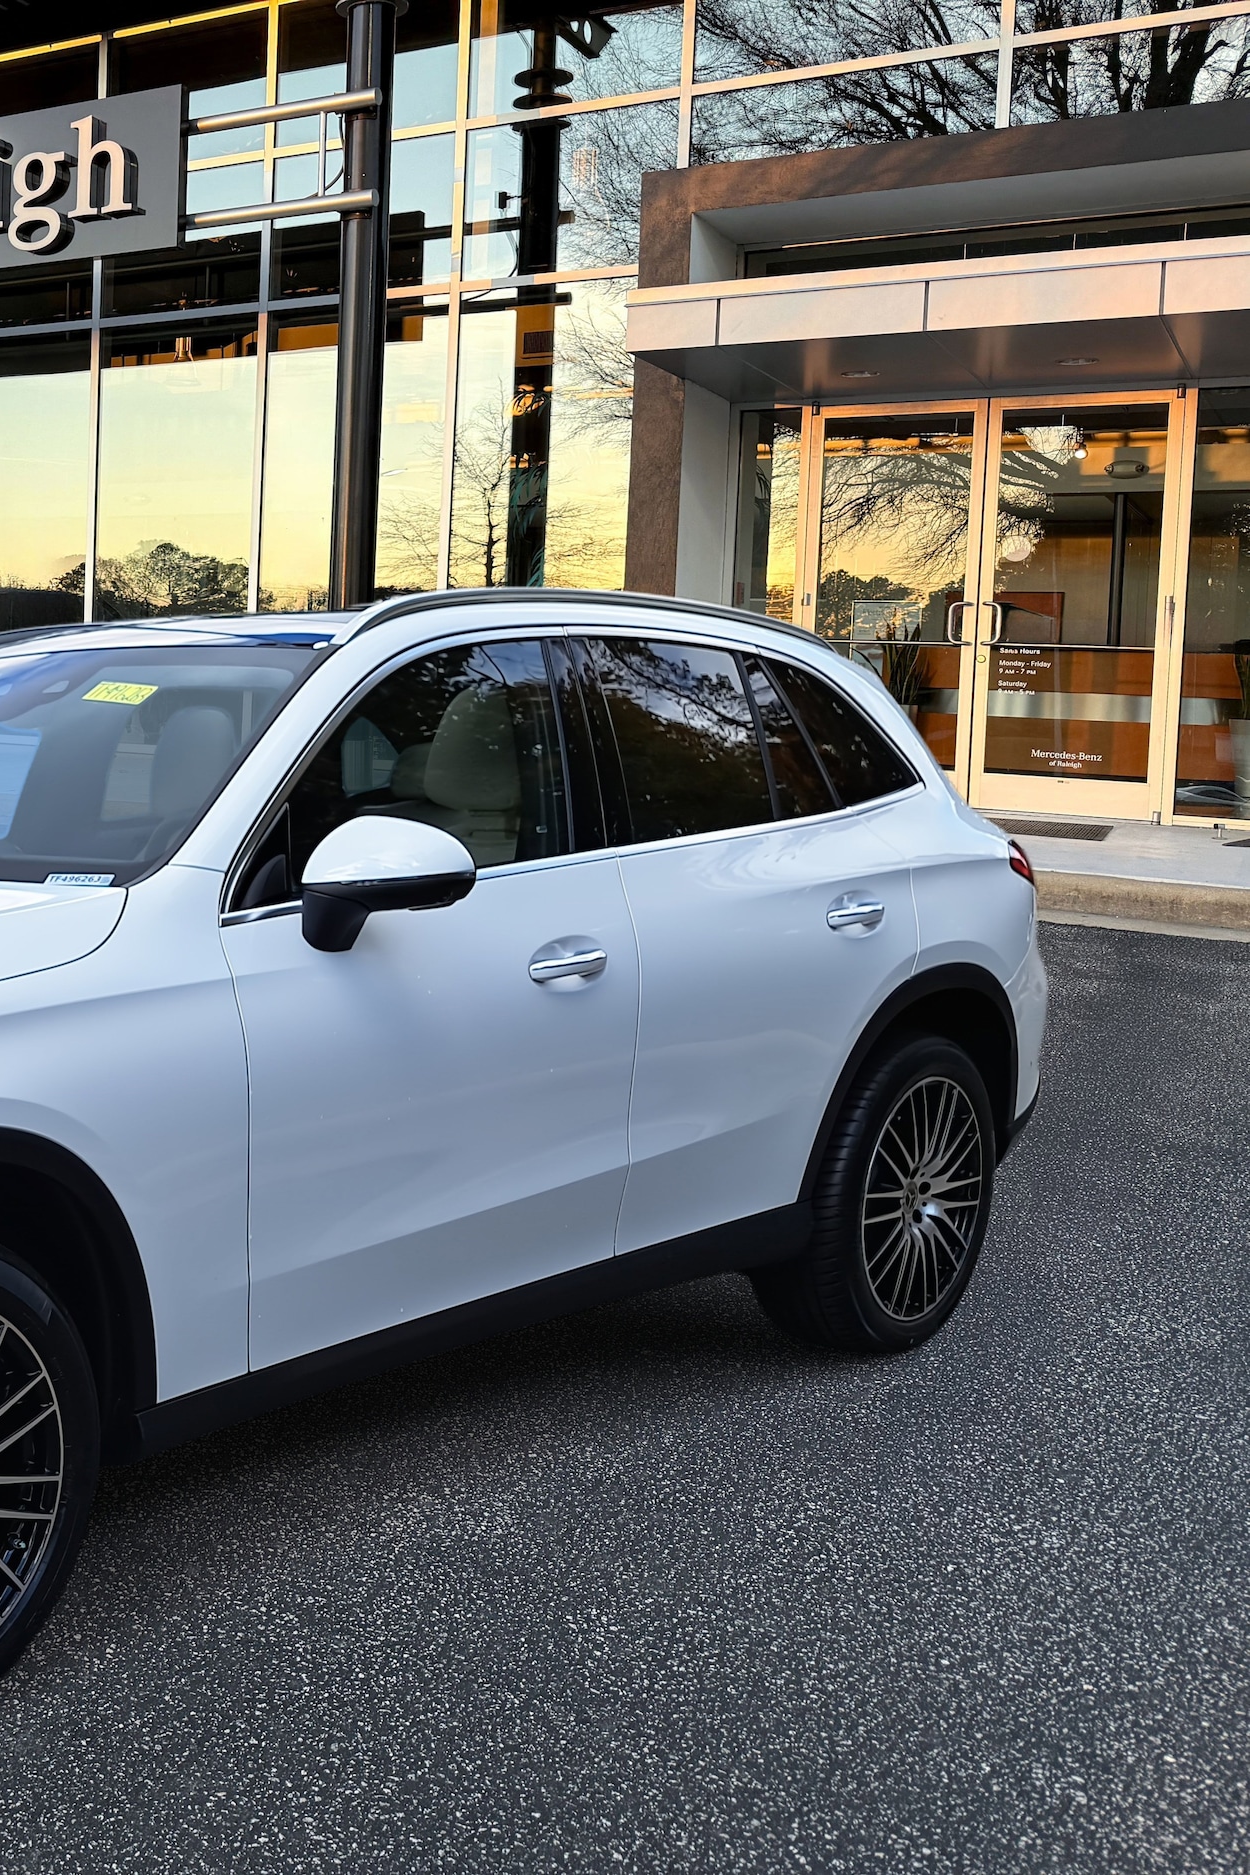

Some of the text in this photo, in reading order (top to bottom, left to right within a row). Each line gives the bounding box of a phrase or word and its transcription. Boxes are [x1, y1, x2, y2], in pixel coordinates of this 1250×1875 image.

[999, 660, 1025, 668] Monday
[998, 680, 1028, 688] Saturday
[1031, 749, 1103, 762] Mercedes-Benz
[1056, 761, 1082, 769] Raleigh
